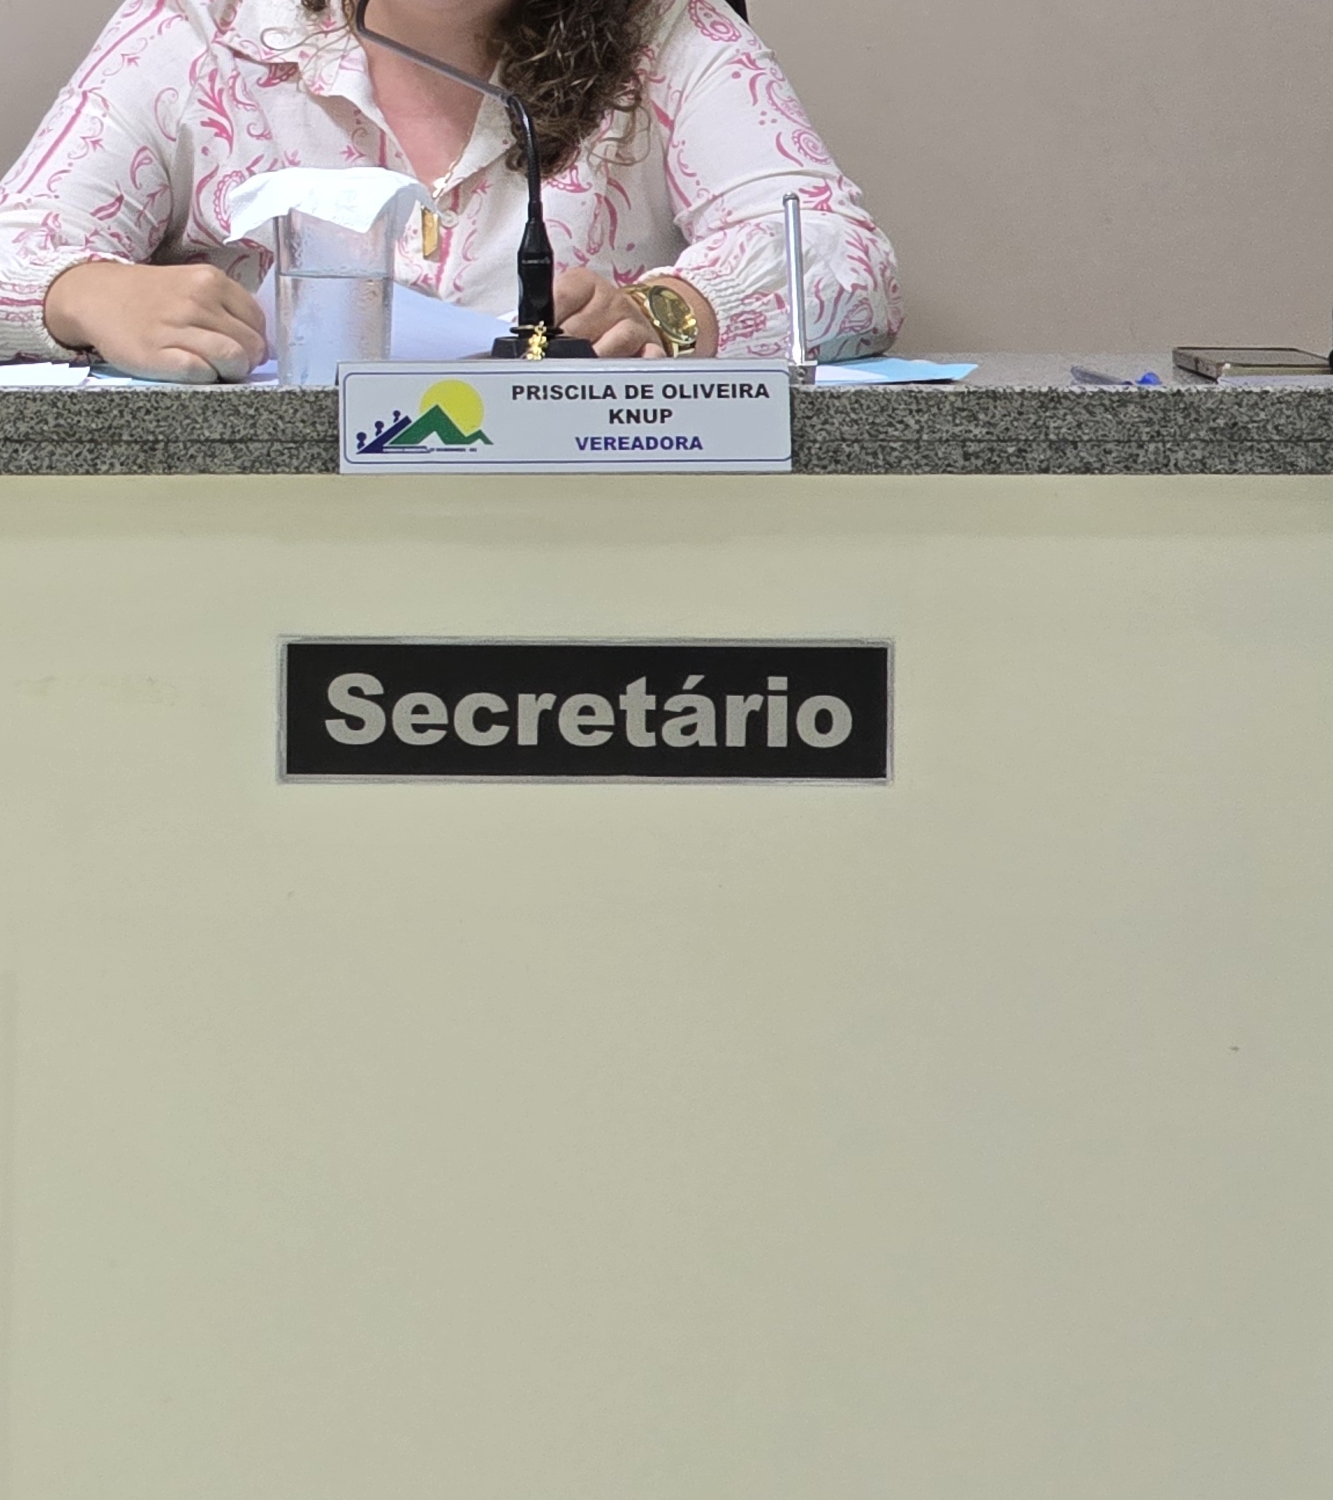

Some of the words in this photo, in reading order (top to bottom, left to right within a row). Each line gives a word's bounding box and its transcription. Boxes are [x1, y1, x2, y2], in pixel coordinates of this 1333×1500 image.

[511, 384, 618, 401] PRISCILA
[624, 384, 655, 400] DE
[661, 383, 770, 400] OLIVEIRA
[608, 408, 673, 425] KNUP
[574, 435, 704, 452] VEREADORA
[324, 672, 853, 748] Secretário
